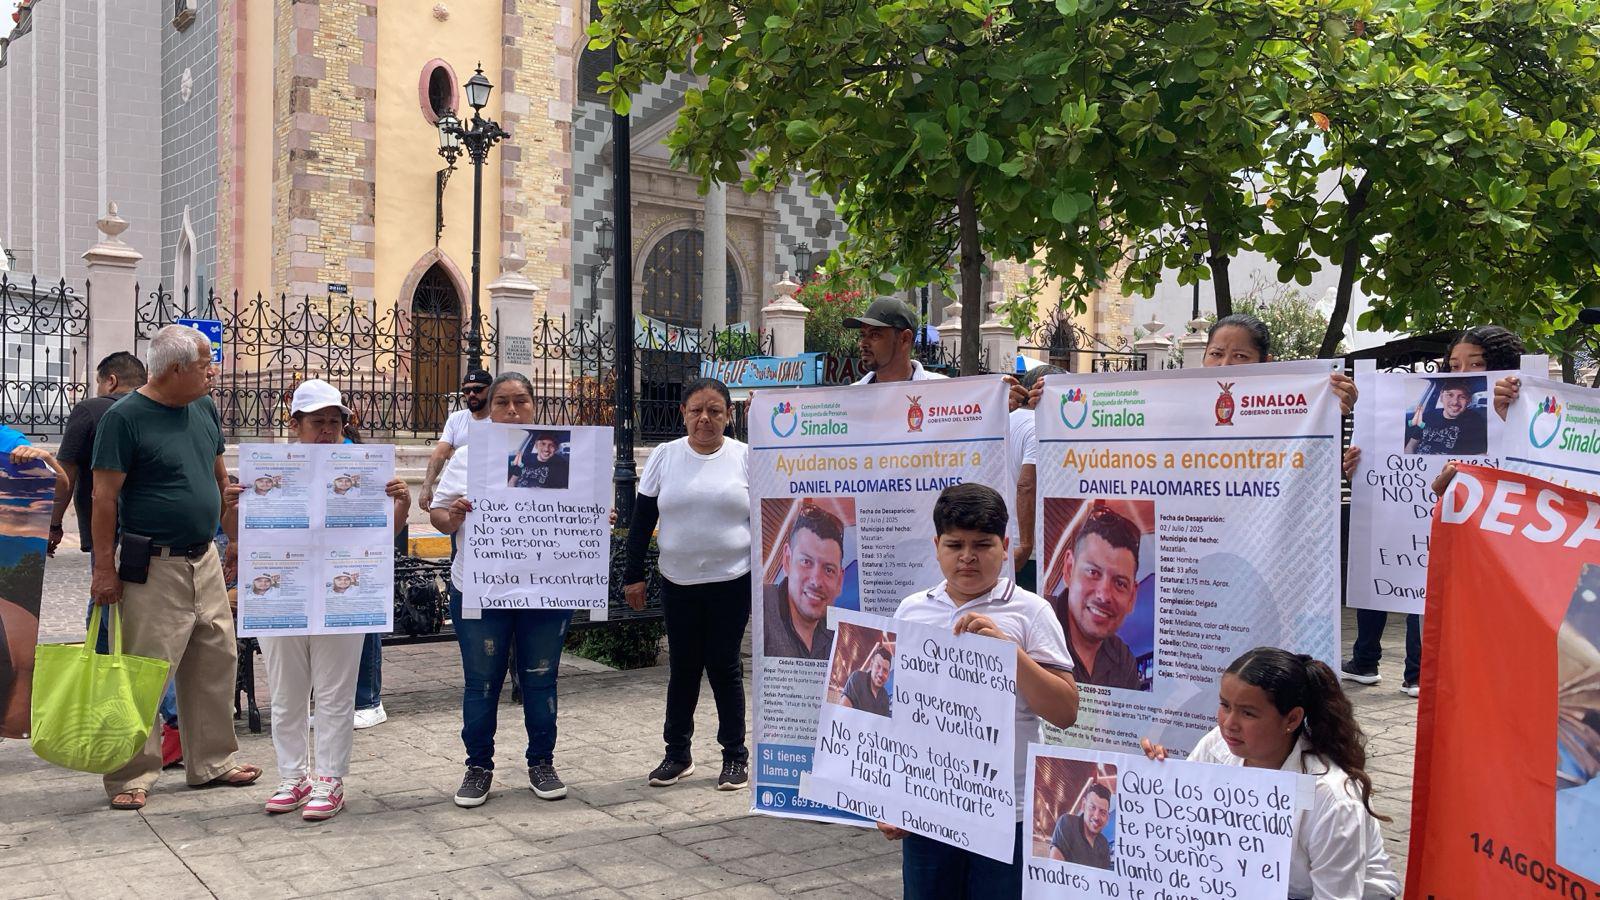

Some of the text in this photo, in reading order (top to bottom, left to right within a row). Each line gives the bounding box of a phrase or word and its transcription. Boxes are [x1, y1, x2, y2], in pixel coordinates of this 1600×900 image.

[1240, 393, 1307, 408] SINALOA
[928, 403, 982, 417] SINALOA
[1092, 408, 1144, 427] Sinaloa
[1283, 407, 1308, 415] ESTADO
[800, 419, 848, 436] Sinaloa
[775, 451, 981, 477] Ayúdanos a encontrar a
[1062, 448, 1304, 473] Ayúdanos a encontrar a
[1387, 455, 1427, 471] Que
[790, 479, 831, 494] DANIEL
[834, 478, 912, 493] PALOMARES
[1366, 470, 1426, 487] Gritos
[1079, 479, 1280, 497] DANIEL PALOMARES LLANES
[514, 500, 554, 512] estan
[557, 501, 606, 514] haciendo
[518, 513, 600, 524] encontrarlos?
[1185, 515, 1225, 523] Desaparición:
[473, 523, 603, 537] No son un numero
[579, 540, 600, 548] con
[1160, 535, 1187, 543] Municipio
[1199, 536, 1219, 544] hecho:
[473, 549, 601, 561] familias y sueños
[473, 571, 609, 586] Hasta Encontrarte
[1160, 576, 1185, 584] Estatura:
[1186, 577, 1198, 585] 1.75
[1172, 587, 1195, 595] Moreno
[479, 596, 606, 608] Daniel Palomares
[1159, 597, 1217, 608] Complexión: Delgada
[1175, 619, 1203, 628] Medianos,
[1218, 623, 1230, 631] café
[1176, 630, 1200, 638] Mediana
[1158, 638, 1181, 647] Cabello:
[1181, 640, 1200, 649] Chino,
[1215, 645, 1230, 653] negro
[923, 638, 1003, 673] Queremos
[1158, 648, 1203, 660] Frente: Pequeña
[1158, 659, 1217, 672] Boca: Mediana, labios
[949, 662, 987, 684] donde
[990, 677, 1017, 695] esta
[1158, 669, 1214, 683] Cejas: Semi pobladas
[914, 689, 982, 721] queremos
[912, 708, 930, 725] de
[831, 720, 851, 741] No
[858, 731, 918, 759] estamos
[763, 748, 807, 763] Si tienes
[763, 764, 798, 777] llama o
[820, 736, 1013, 806] Nos falta Daniel Palomares
[851, 760, 995, 818] Hasta Encontrarte
[1122, 770, 1291, 811] Que los ojos de
[836, 791, 970, 847] Daniel Palomares
[1118, 792, 1293, 838] los Desaparecidos
[1118, 814, 1265, 854] te persigan en
[1117, 837, 1145, 859] tus
[1261, 860, 1280, 882] el
[1470, 832, 1587, 900] 14 AGOSTO
[1116, 857, 1163, 885] llanto
[1169, 871, 1191, 889] de
[1028, 864, 1090, 892] madres
[1099, 879, 1120, 898] no
[1128, 881, 1144, 900] te
